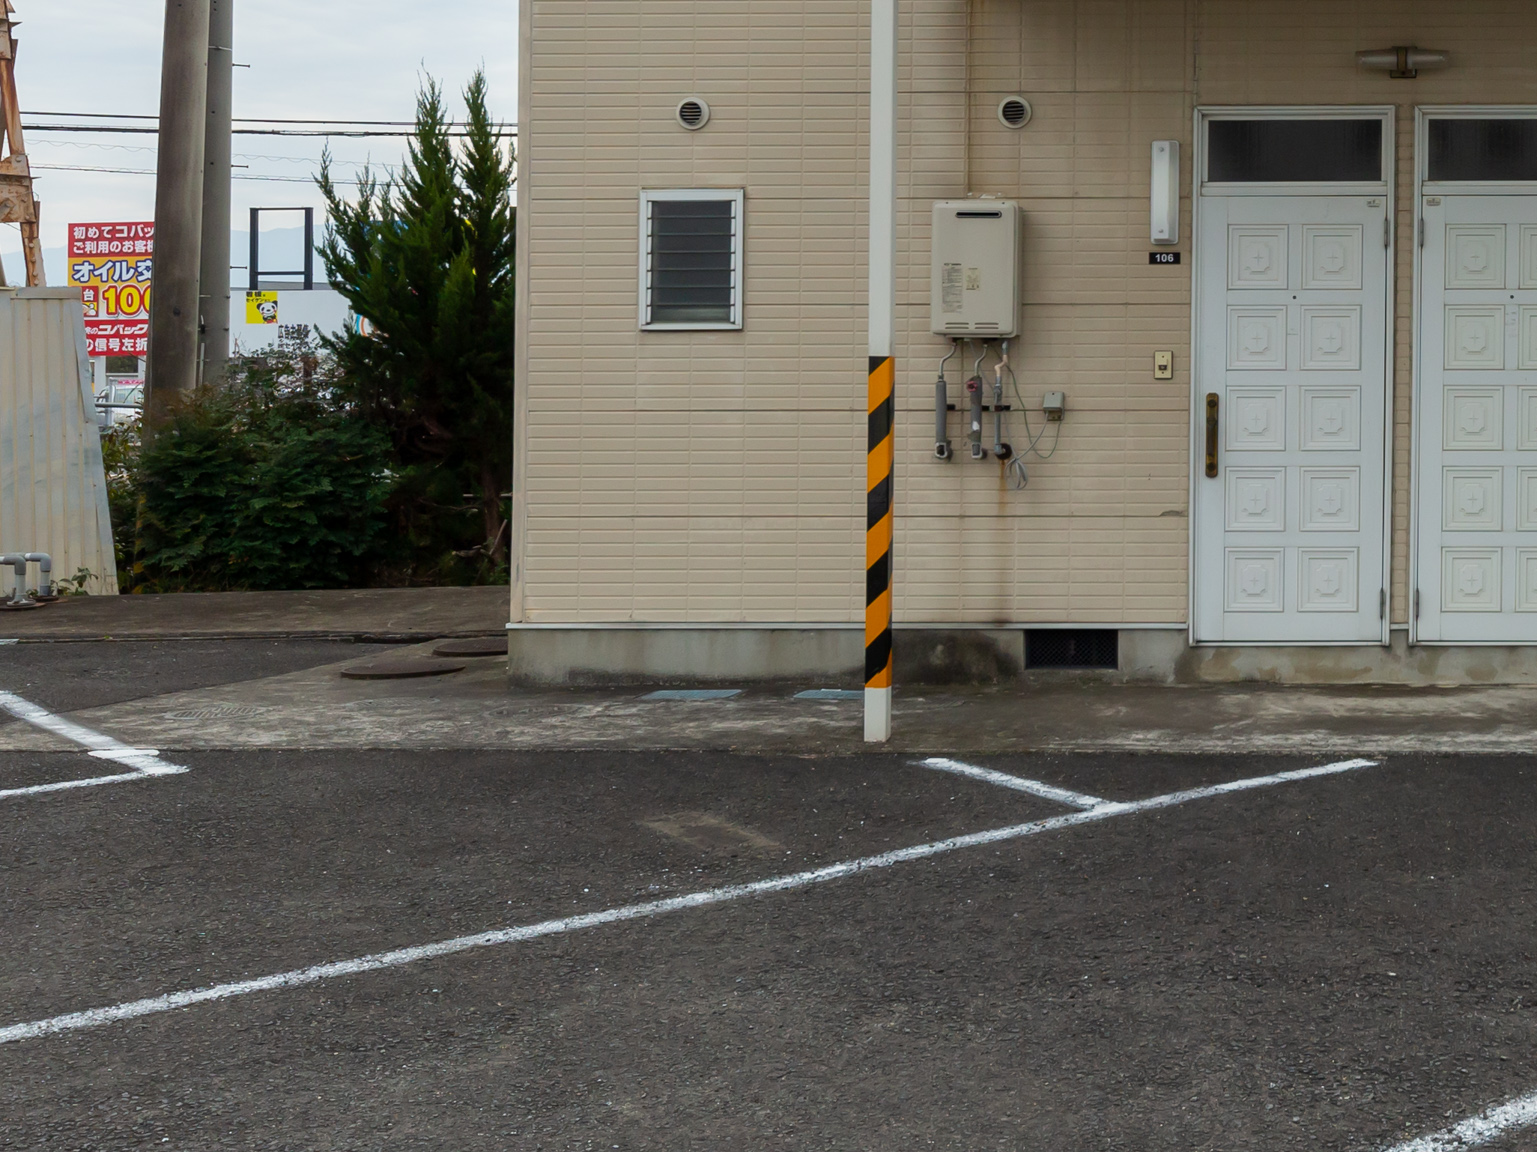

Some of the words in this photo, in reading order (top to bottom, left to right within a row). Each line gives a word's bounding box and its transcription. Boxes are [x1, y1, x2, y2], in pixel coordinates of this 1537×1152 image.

[73, 224, 155, 239] 初めてコバッ
[1155, 253, 1174, 263] 106
